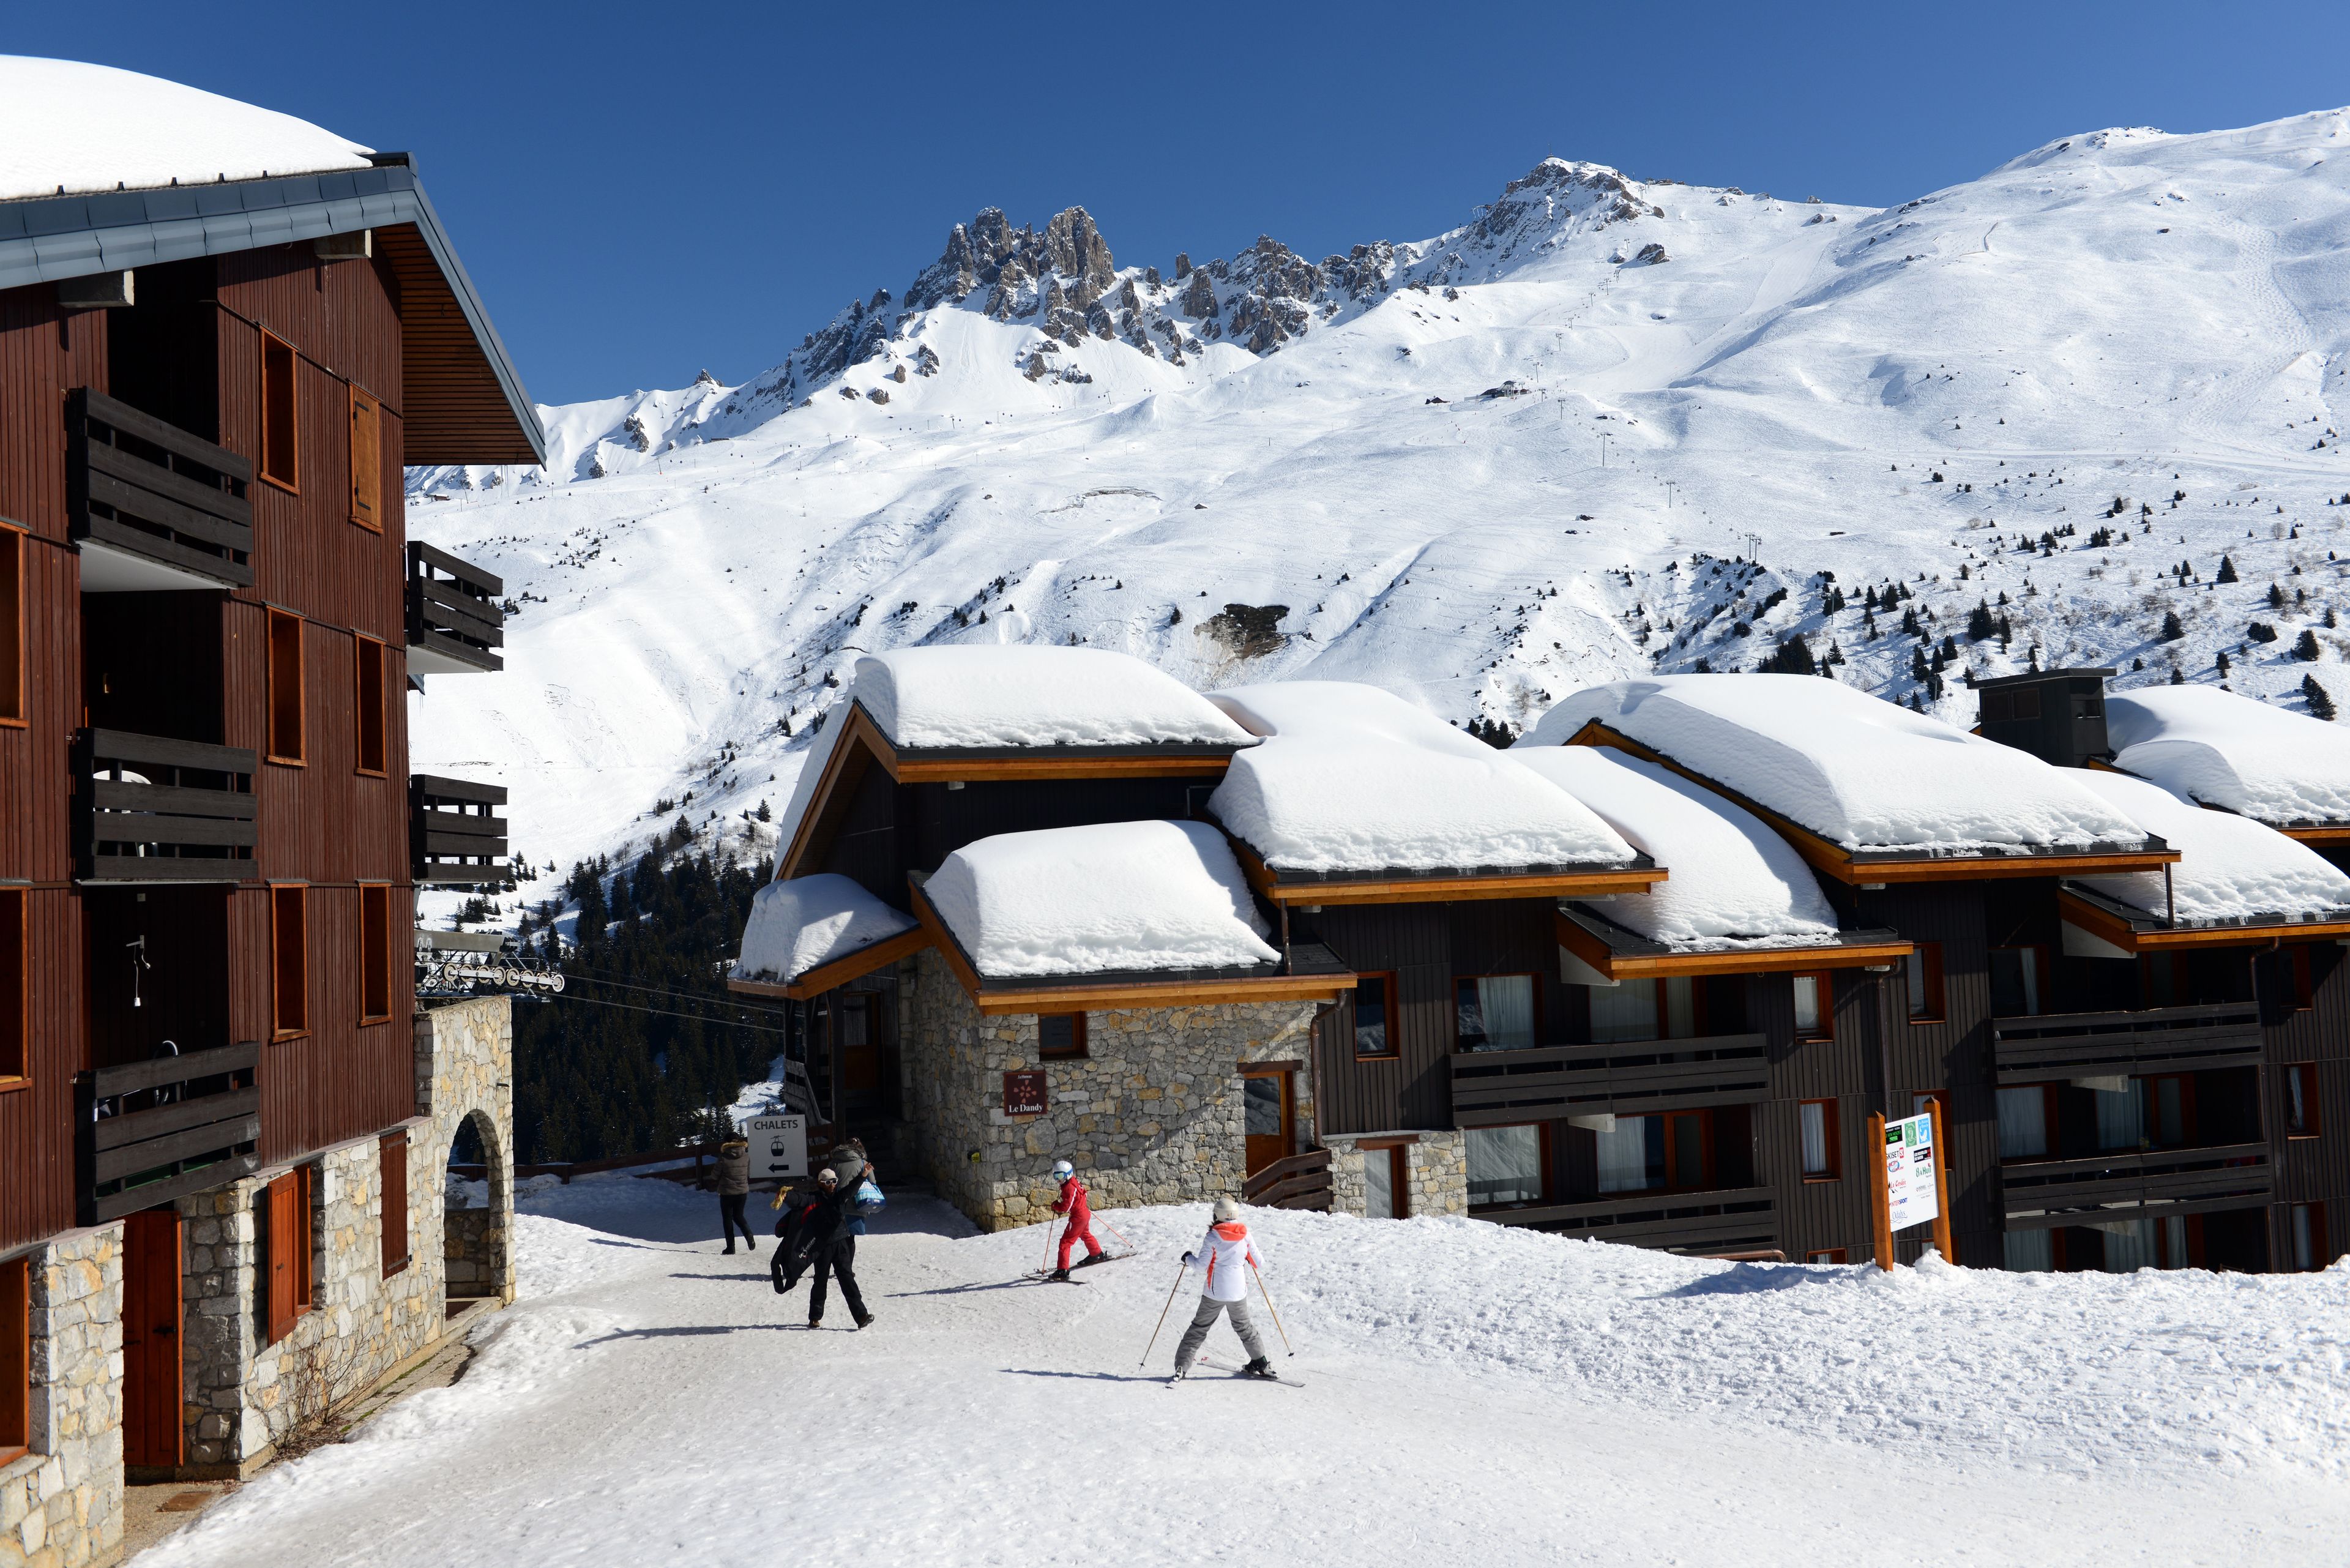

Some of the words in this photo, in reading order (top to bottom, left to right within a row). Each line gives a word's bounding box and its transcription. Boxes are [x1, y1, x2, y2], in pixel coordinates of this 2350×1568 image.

[1020, 1103, 1043, 1113] Dandy
[754, 1119, 798, 1130] CHALETS
[1886, 1151, 1899, 1160] SKISET
[1916, 1167, 1920, 1178] 8
[1890, 1198, 1908, 1207] INTERSPORT
